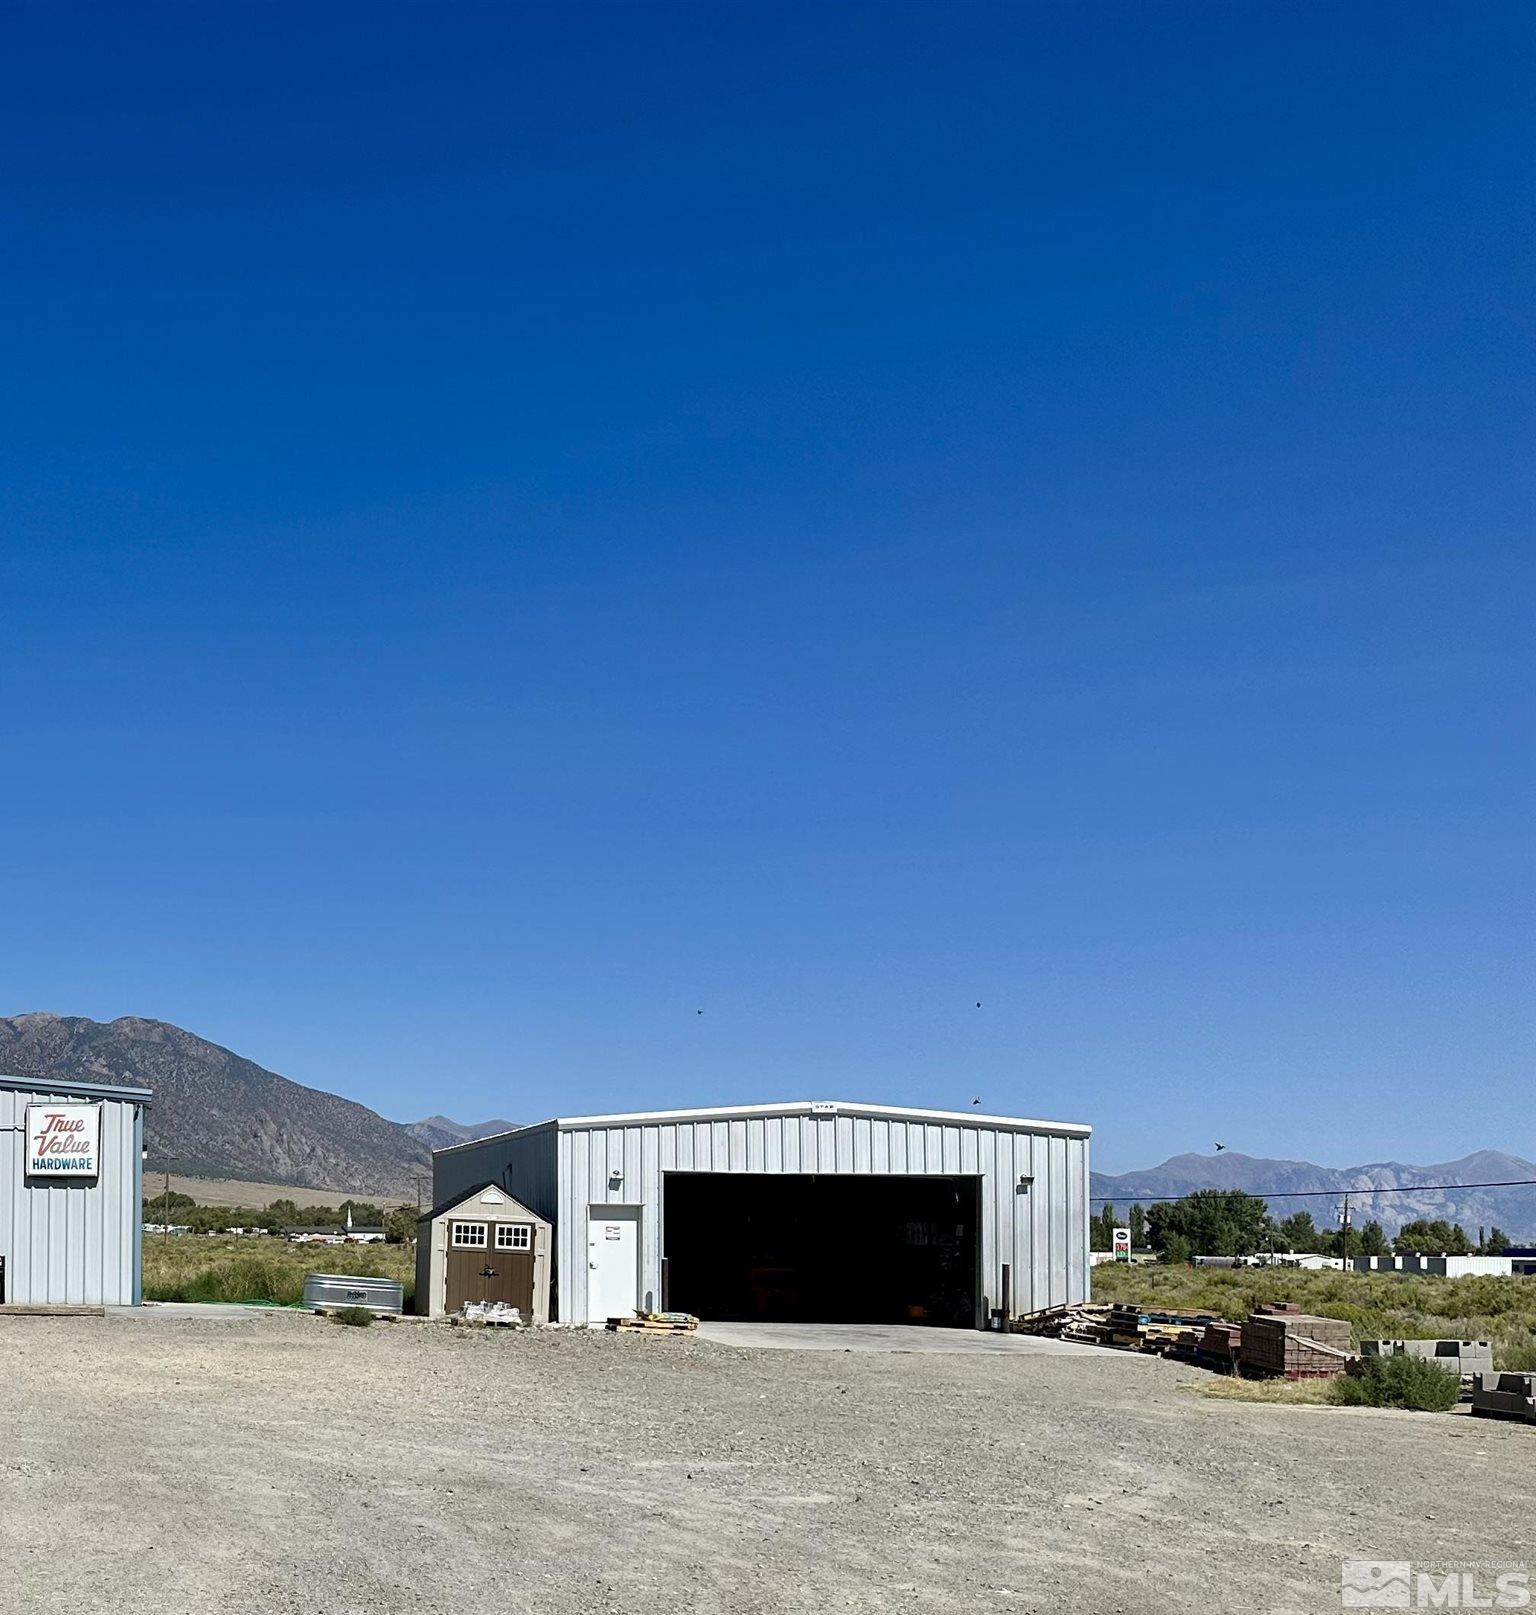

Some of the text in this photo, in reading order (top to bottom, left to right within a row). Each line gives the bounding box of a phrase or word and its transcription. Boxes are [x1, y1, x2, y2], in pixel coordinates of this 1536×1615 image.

[40, 1114, 85, 1134] True
[33, 1134, 90, 1156] Value
[32, 1158, 93, 1170] HARDWARE
